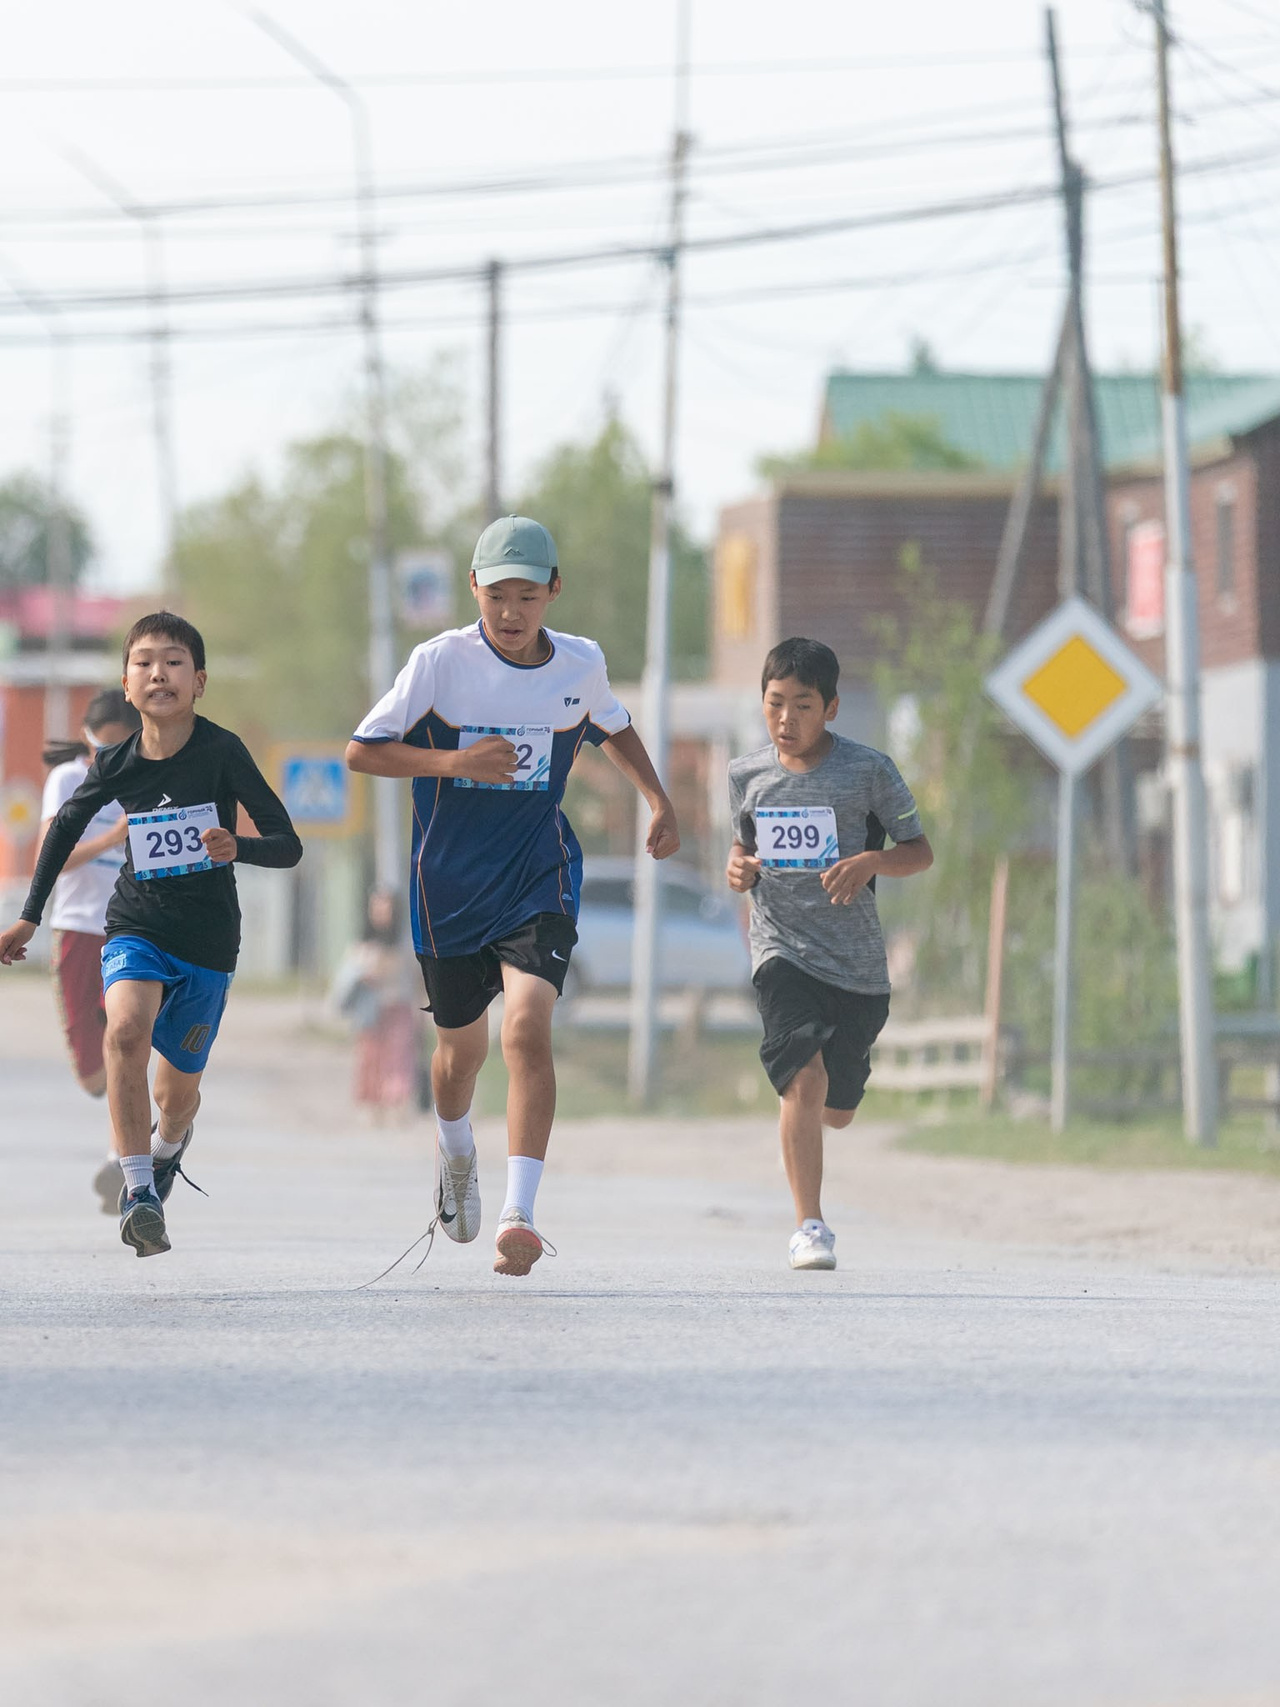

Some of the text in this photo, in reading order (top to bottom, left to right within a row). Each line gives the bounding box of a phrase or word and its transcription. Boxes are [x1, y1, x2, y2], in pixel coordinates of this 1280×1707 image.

[146, 826, 203, 858] 293
[771, 825, 820, 850] 299
[180, 1023, 211, 1054] 10
